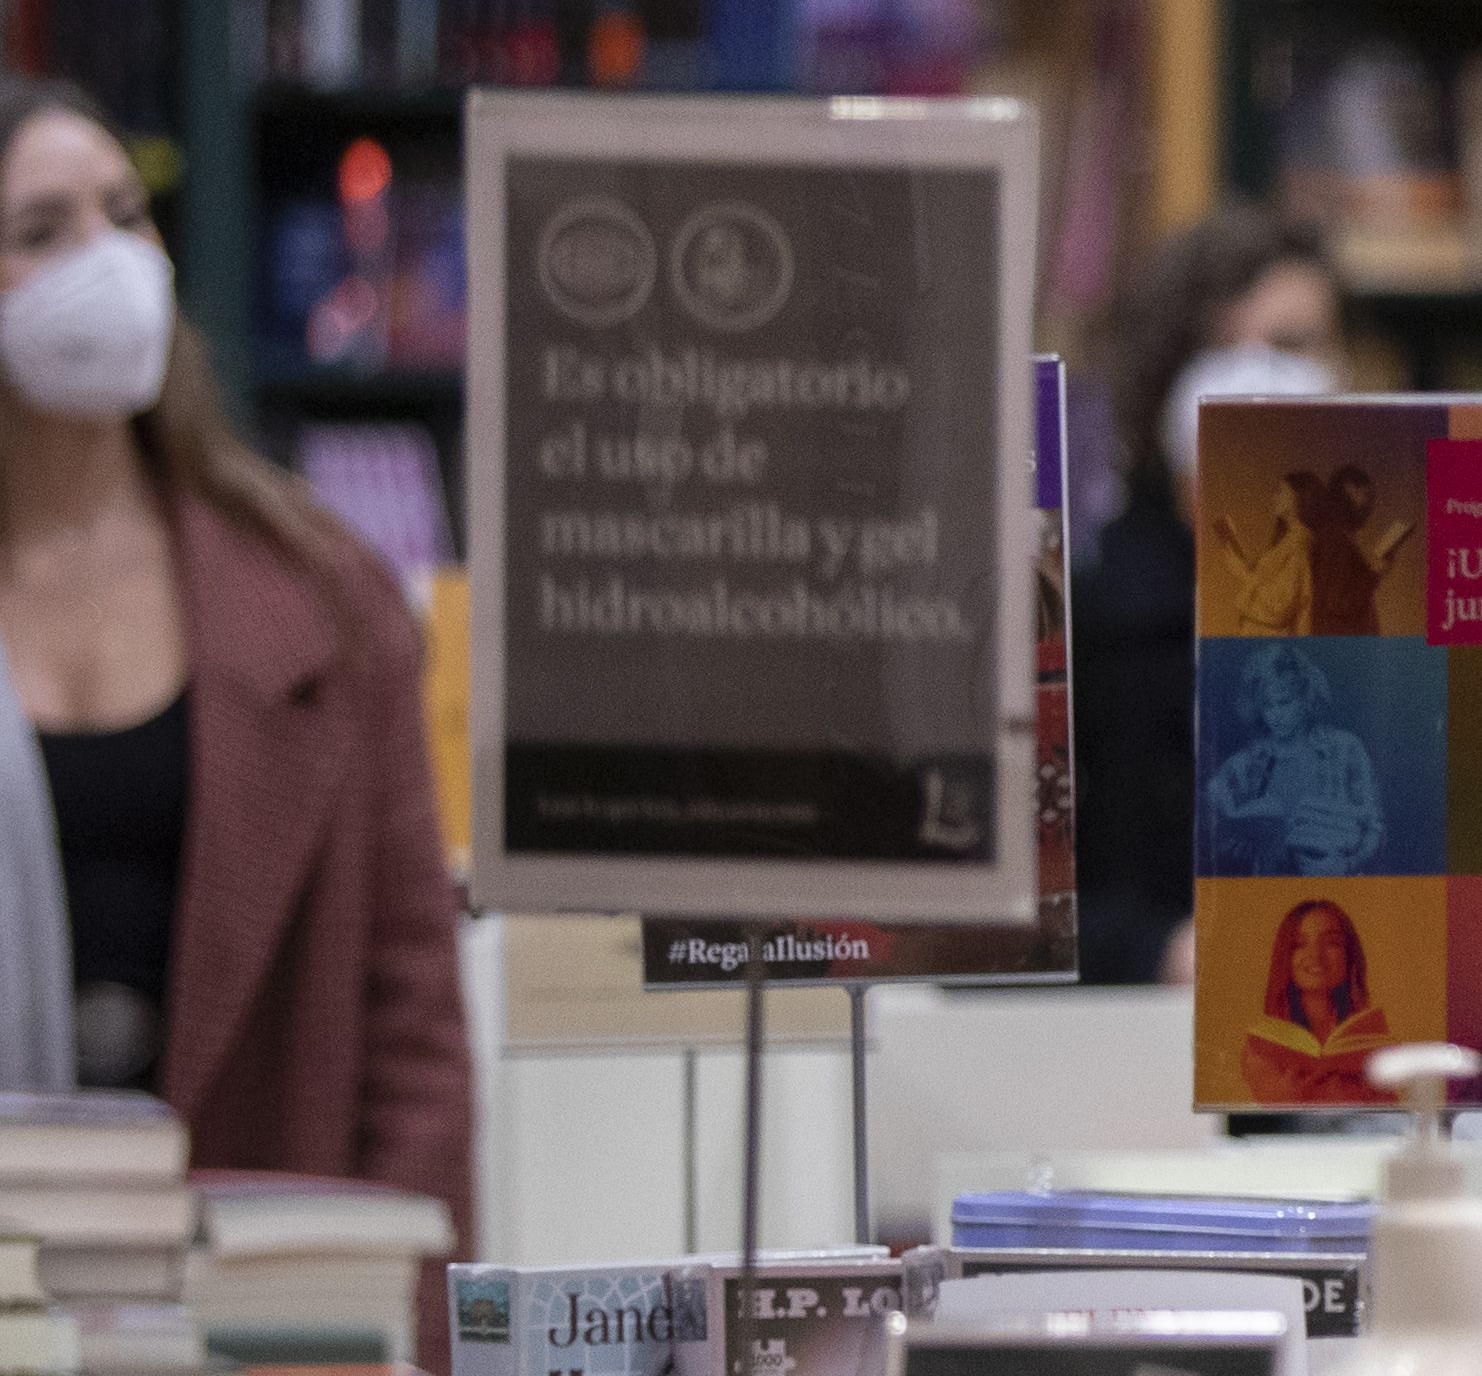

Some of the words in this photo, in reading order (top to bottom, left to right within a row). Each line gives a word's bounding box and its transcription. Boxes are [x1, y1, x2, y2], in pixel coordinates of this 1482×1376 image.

[543, 347, 604, 405] Es
[612, 345, 911, 417] obligatorio
[540, 427, 589, 480] el
[601, 435, 690, 483] uso
[702, 429, 769, 485] de
[541, 499, 811, 560] mascarilla
[818, 521, 858, 576] y
[858, 507, 940, 579] gel
[548, 1292, 674, 1347] Jane
